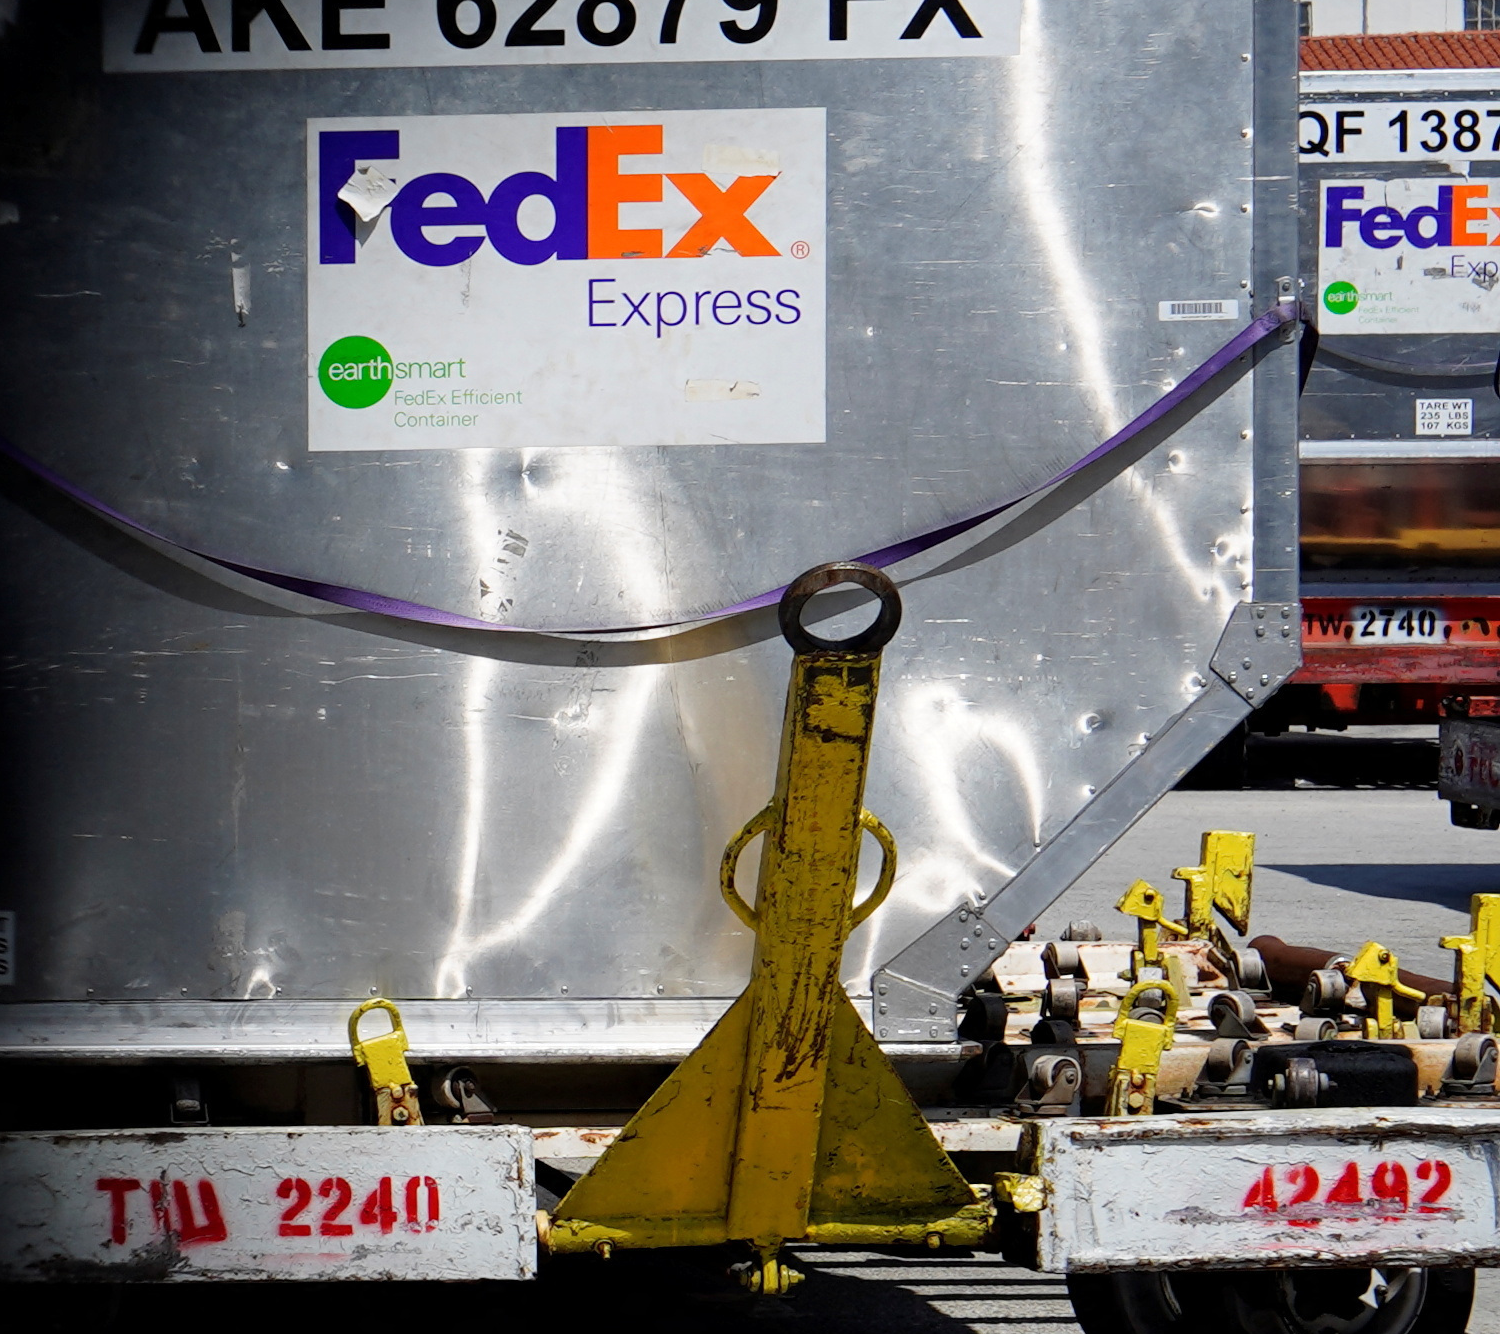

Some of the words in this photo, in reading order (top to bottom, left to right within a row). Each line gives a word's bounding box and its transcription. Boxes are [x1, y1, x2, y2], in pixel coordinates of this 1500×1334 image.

[318, 124, 783, 267] FedEx
[1325, 184, 1500, 249] FedE
[588, 278, 802, 338] Express
[394, 389, 447, 406] FedEx
[451, 388, 523, 406] Efficient
[1419, 402, 1449, 411] TARE
[1452, 402, 1470, 411] WT
[393, 411, 478, 428] Container
[1420, 422, 1440, 430] 107
[1448, 412, 1469, 420] LBS
[1360, 609, 1437, 637] 2740
[276, 1175, 441, 1238] 2240
[1242, 1160, 1453, 1228] 42492
